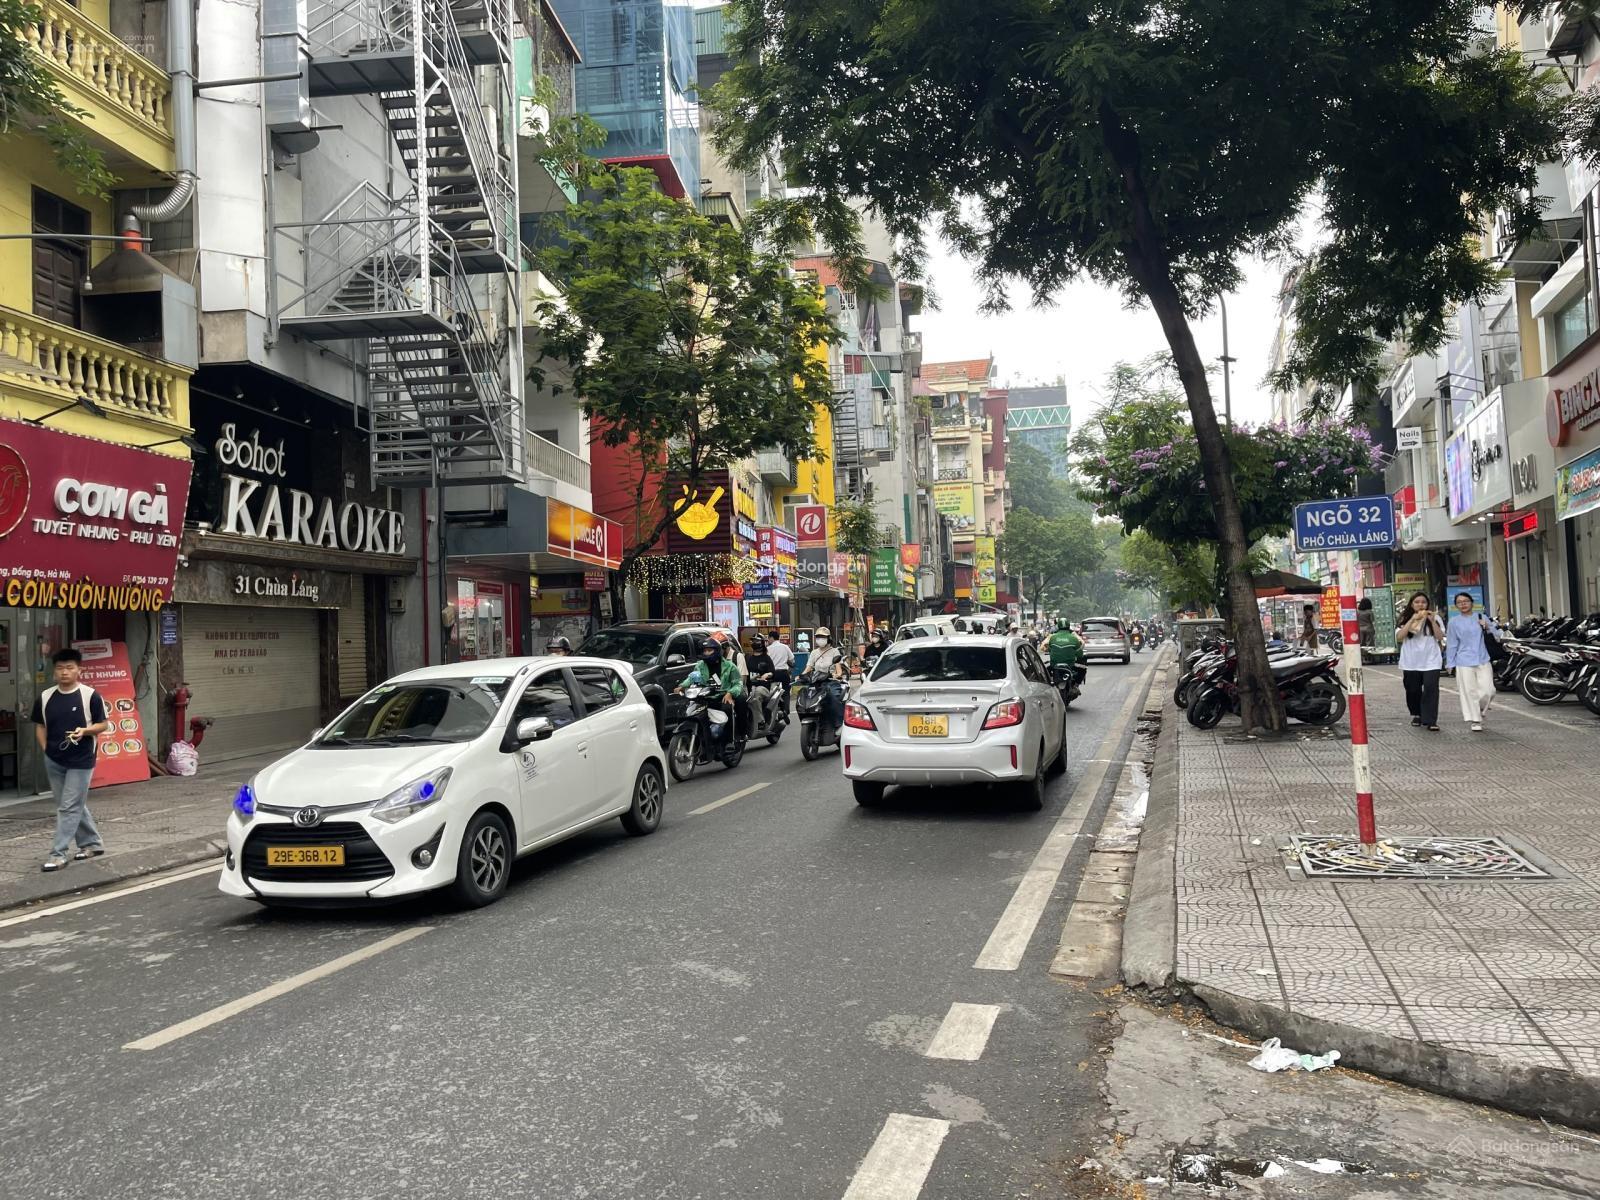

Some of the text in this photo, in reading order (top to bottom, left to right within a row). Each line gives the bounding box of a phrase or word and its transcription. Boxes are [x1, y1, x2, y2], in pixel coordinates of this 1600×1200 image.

[1399, 430, 1420, 438] Nails
[216, 423, 286, 478] Sohot
[54, 478, 169, 526] CƠM GÀ
[220, 474, 406, 555] KARAOKE
[1306, 504, 1381, 528] NGÕ 32
[32, 515, 75, 536] TUYẾT
[77, 524, 119, 541] NHUNG
[130, 528, 152, 544] PHÚ
[156, 530, 177, 547] YÊN
[1303, 530, 1389, 547] PHỐ CHÙA LÁNG
[235, 575, 319, 602] 31 Chùa Láng
[981, 588, 993, 597] 61
[96, 670, 127, 679] NHUNG
[912, 725, 944, 735] 029.42
